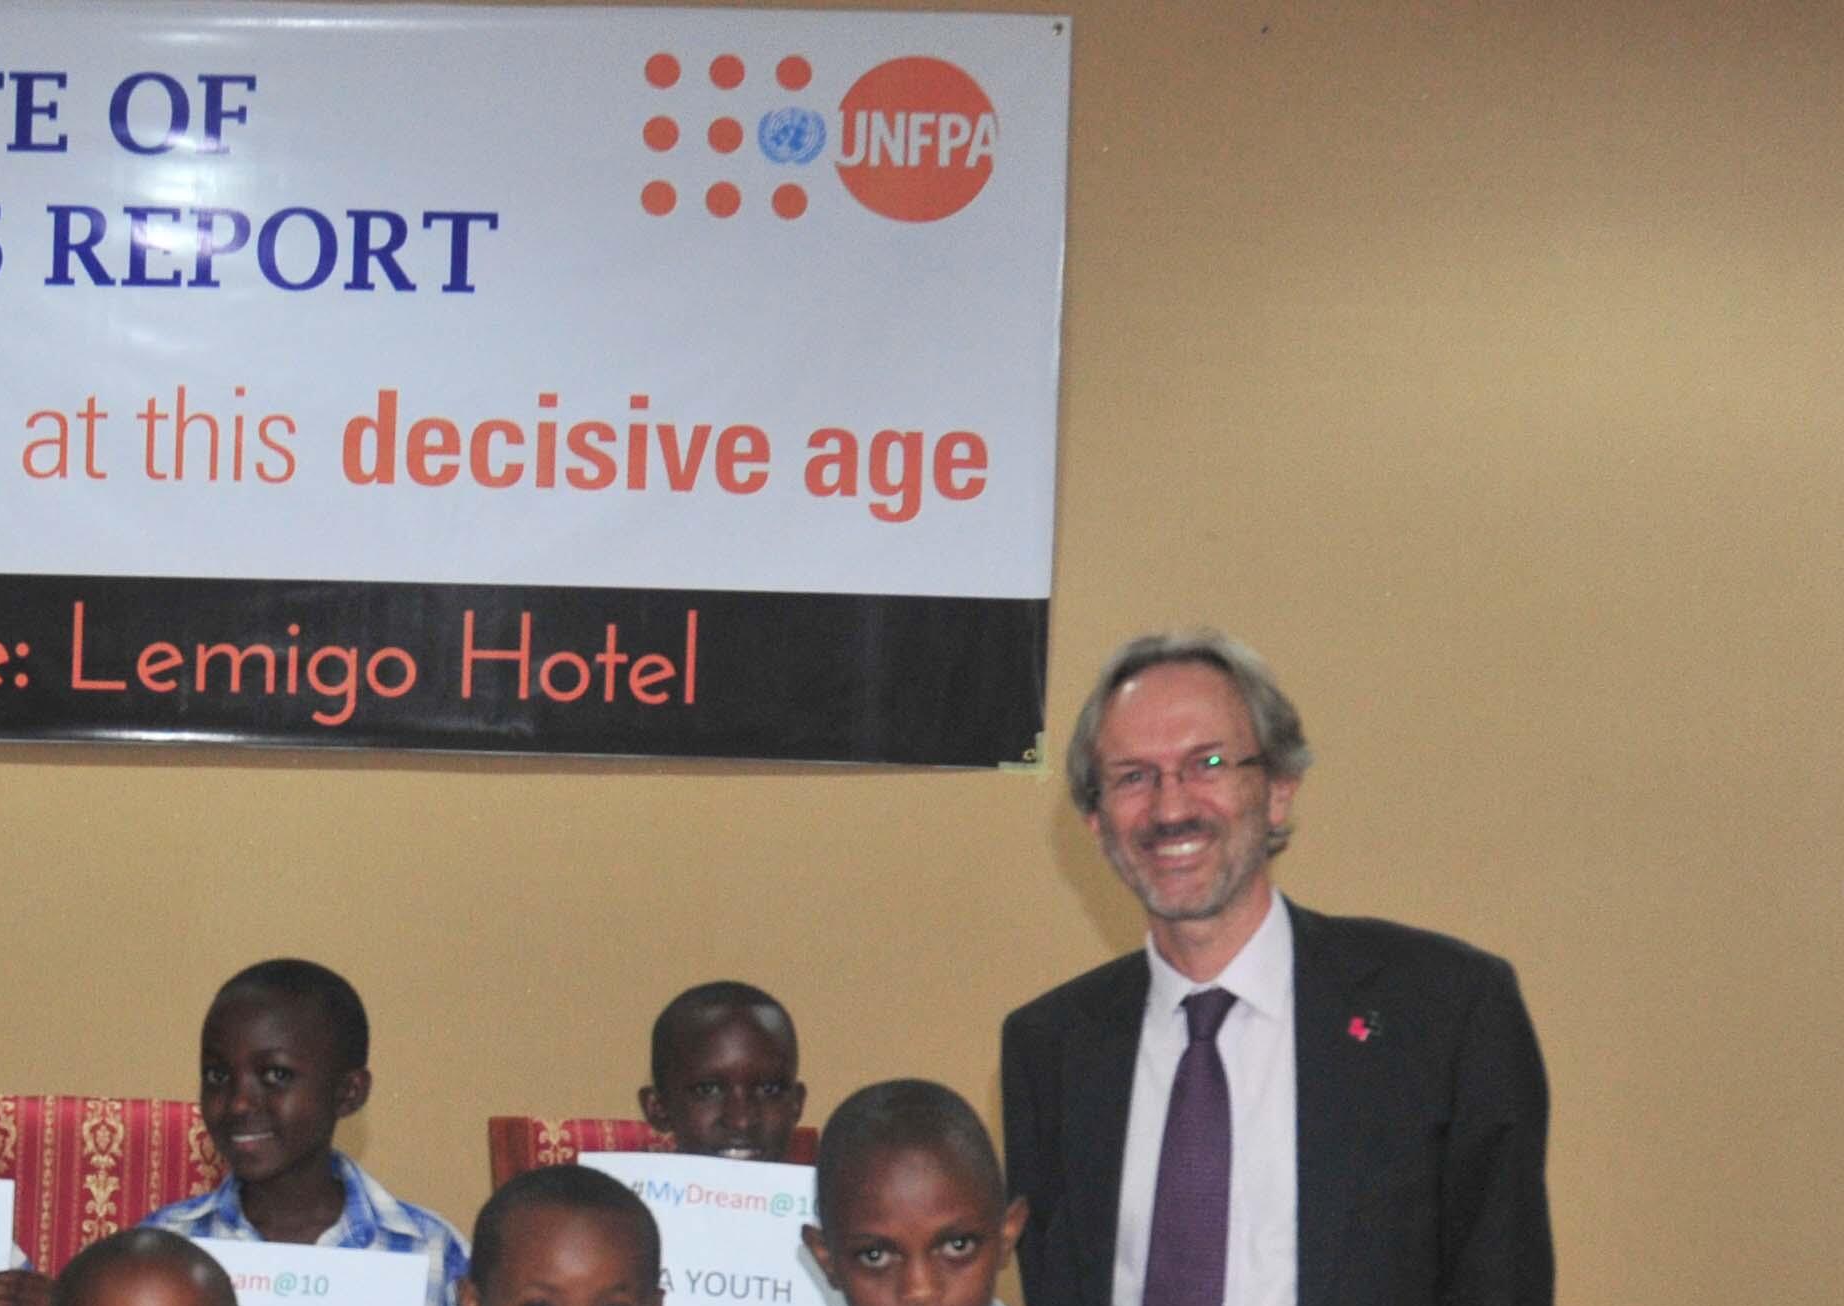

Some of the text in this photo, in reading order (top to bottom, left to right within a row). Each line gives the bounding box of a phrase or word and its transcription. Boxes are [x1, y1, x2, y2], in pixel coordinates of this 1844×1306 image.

[108, 70, 256, 155] OF
[837, 110, 997, 168] UNFPA
[44, 203, 498, 293] REPORT
[23, 396, 108, 479] at
[137, 385, 296, 483] this
[343, 390, 771, 494] decisive
[805, 428, 988, 522] age
[70, 602, 418, 726] Lemigo
[461, 610, 697, 704] Hotel
[686, 1270, 792, 1303] YOUTH
